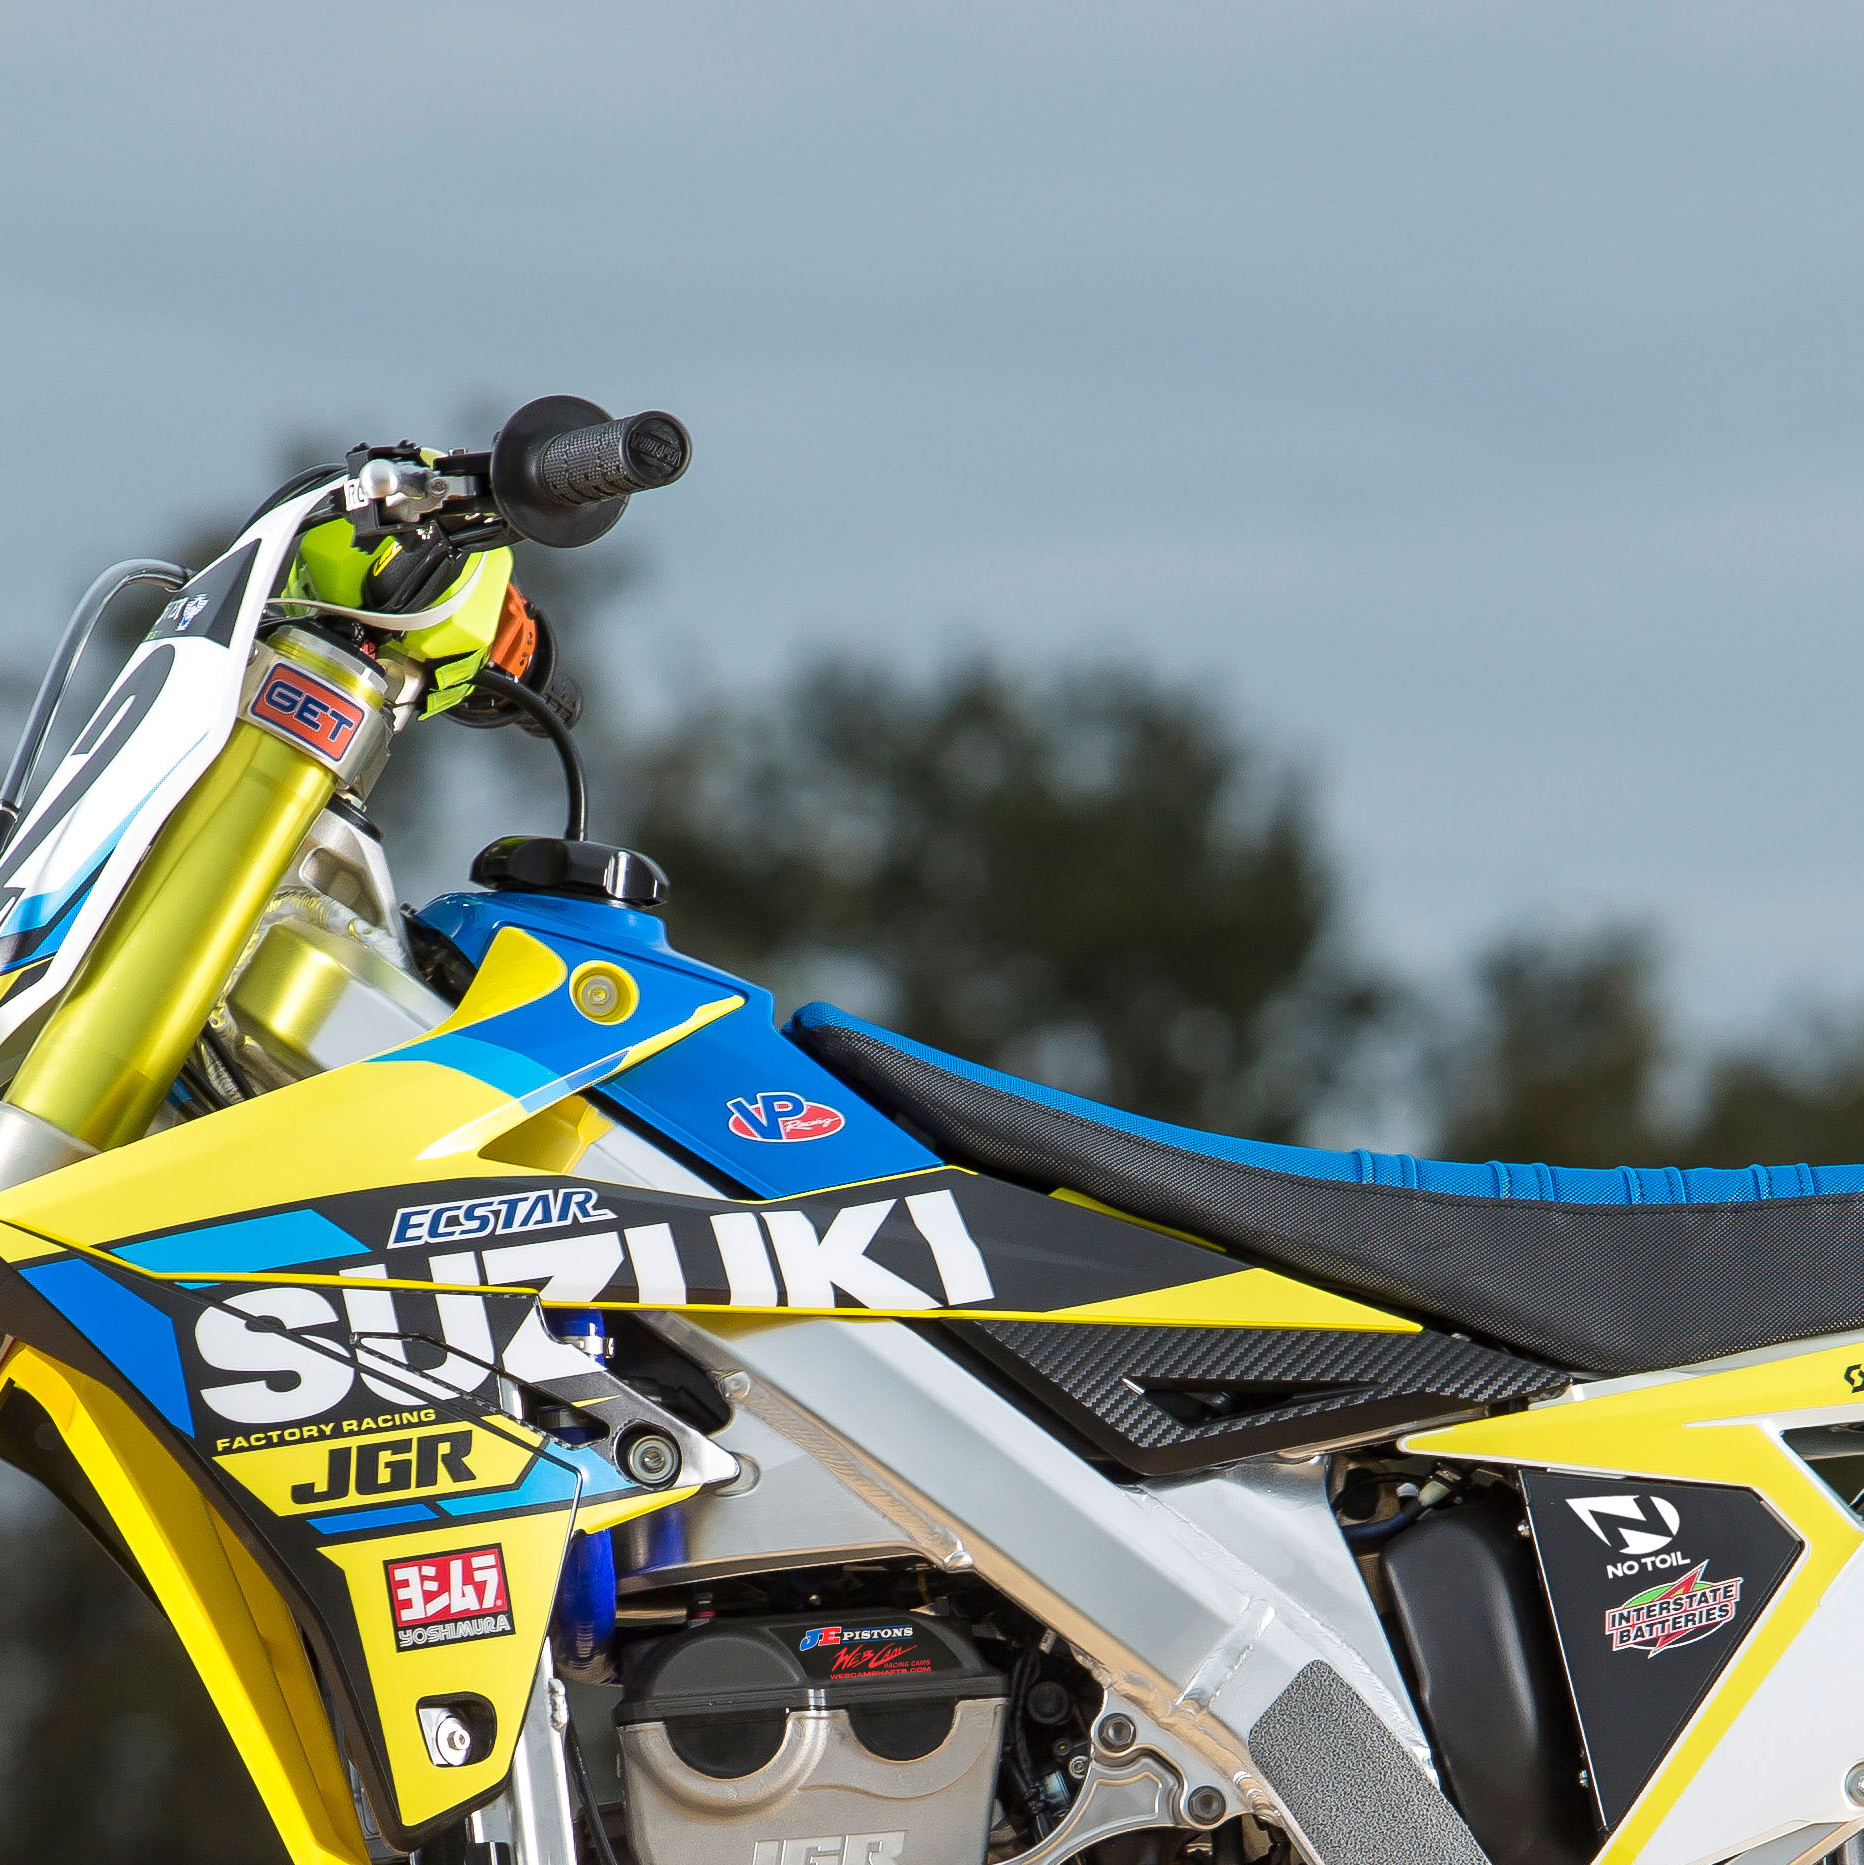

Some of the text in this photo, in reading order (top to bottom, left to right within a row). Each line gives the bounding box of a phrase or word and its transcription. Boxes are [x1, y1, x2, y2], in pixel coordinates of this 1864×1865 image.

[264, 679, 356, 742] GET
[726, 1091, 807, 1143] VP
[388, 1186, 617, 1248] ECSTAR
[193, 1188, 998, 1425] SUZUKI
[215, 1406, 438, 1453] FACTORY RACING
[290, 1429, 477, 1506] JGR
[393, 1554, 499, 1622] ヨシムラ
[1606, 1551, 1691, 1580] NO TOIL
[1610, 1584, 1735, 1628] INTERSTATE
[1618, 1604, 1731, 1645] BATTERIES
[397, 1614, 512, 1648] YOSHIMURA
[799, 1627, 913, 1651] JE PISTONS
[830, 1666, 932, 1680] WEBCAMSHAFTS.COM
[884, 1661, 909, 1669] RACING
